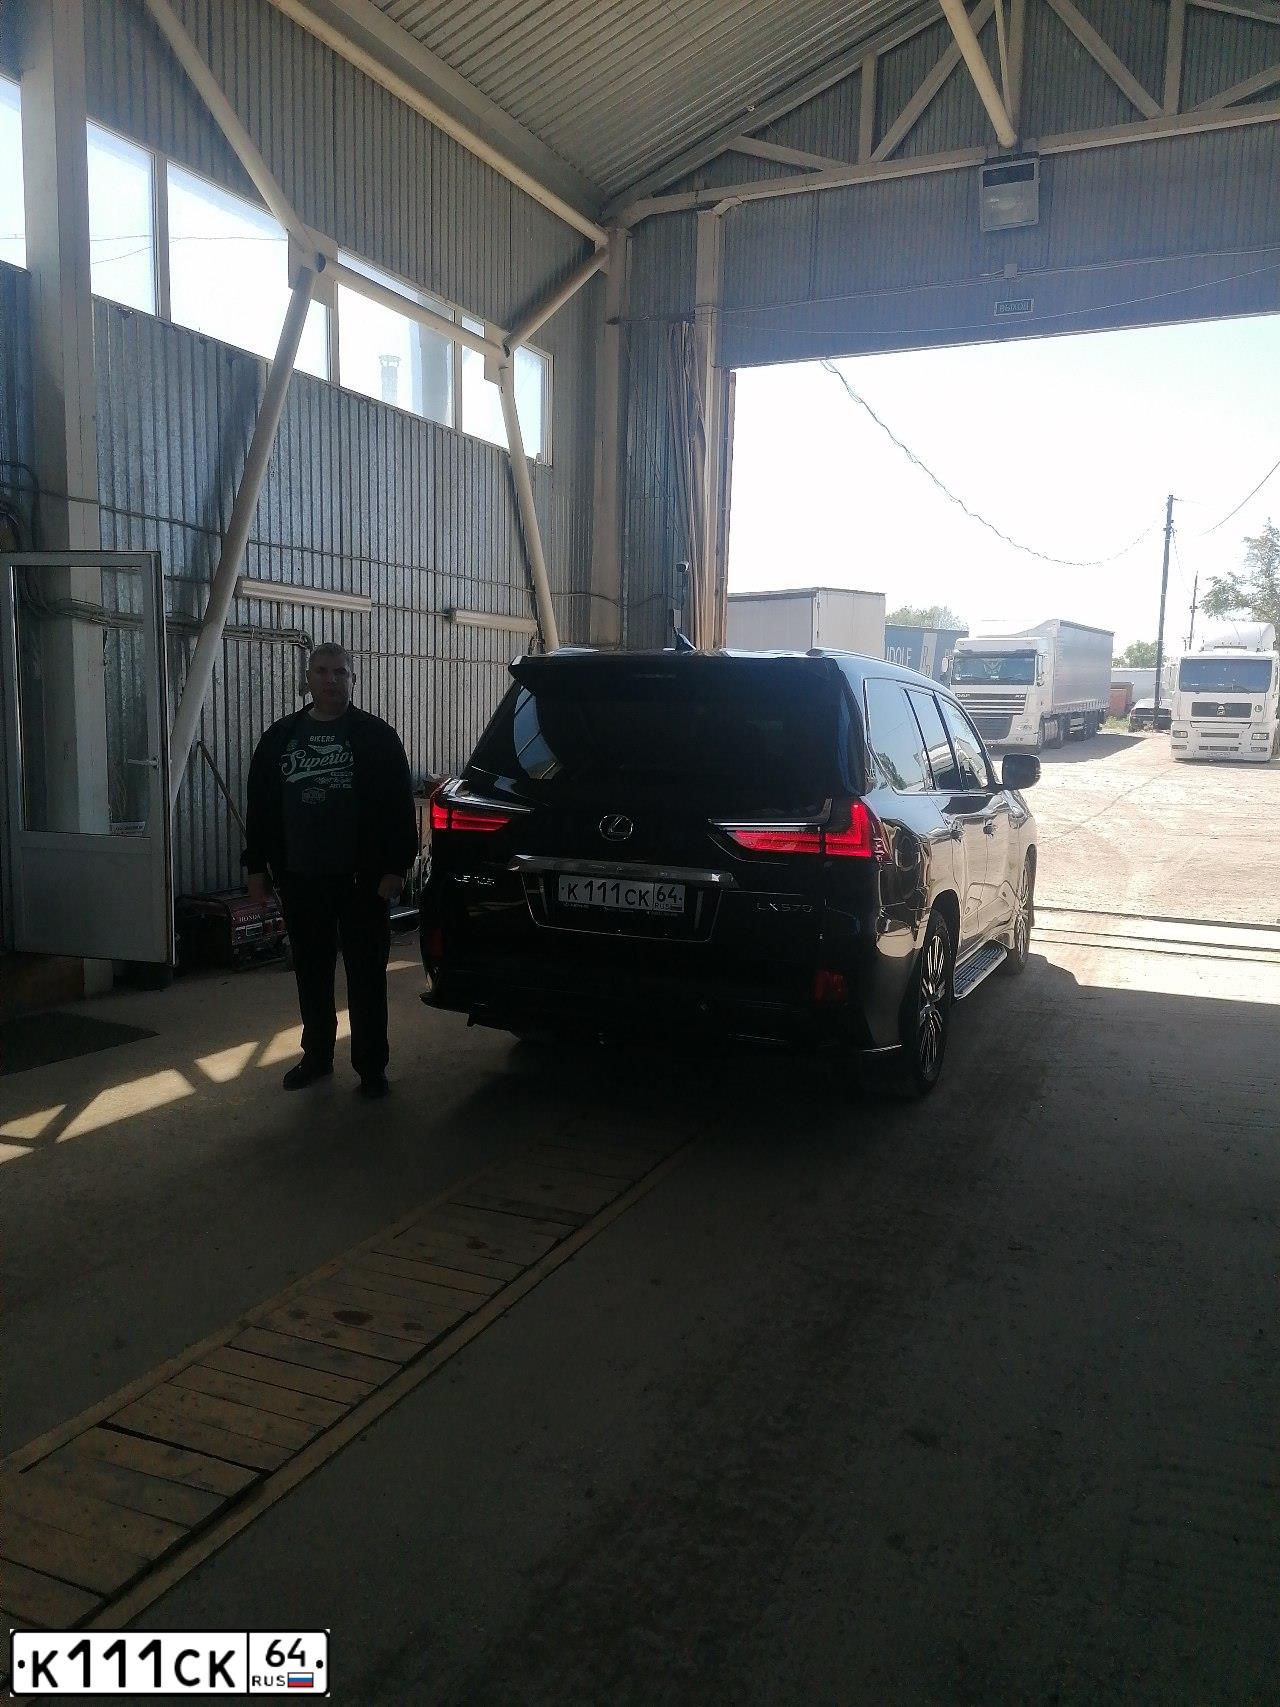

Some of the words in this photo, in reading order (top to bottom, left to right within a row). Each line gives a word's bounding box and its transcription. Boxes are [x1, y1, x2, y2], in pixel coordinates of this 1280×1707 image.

[567, 880, 650, 907] К111СК
[656, 885, 677, 904] 64
[654, 902, 671, 910] RUS
